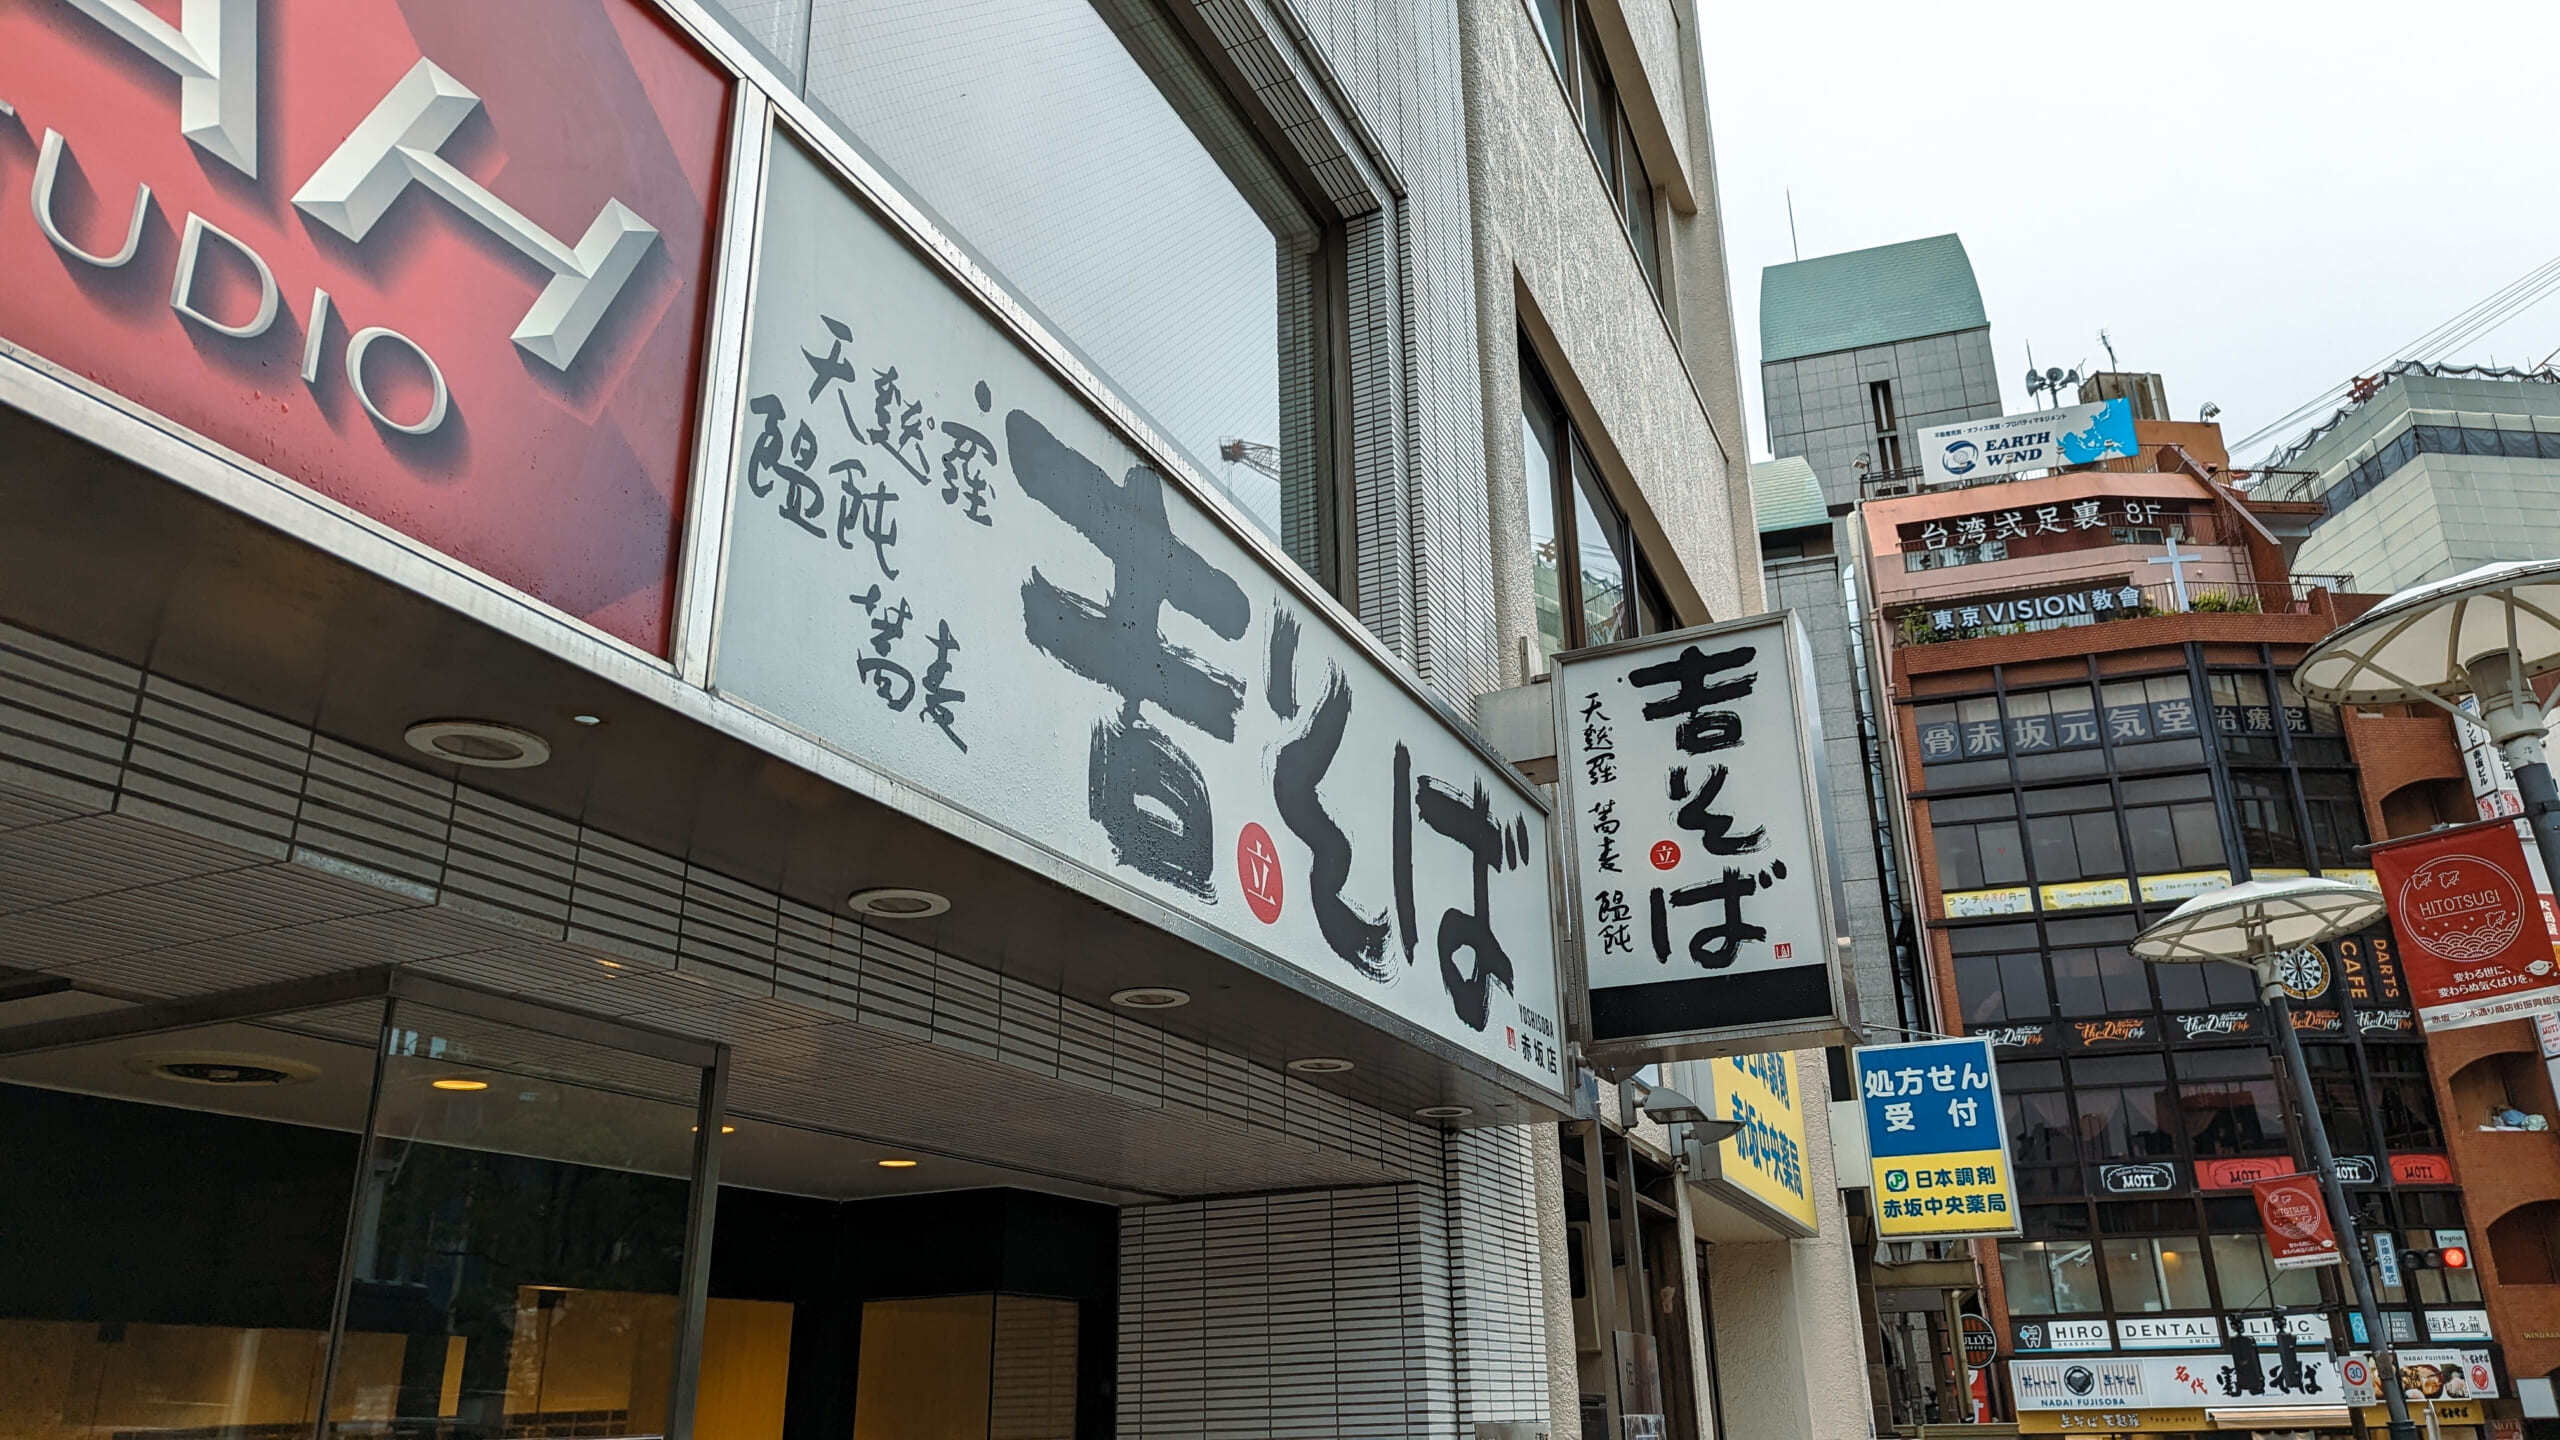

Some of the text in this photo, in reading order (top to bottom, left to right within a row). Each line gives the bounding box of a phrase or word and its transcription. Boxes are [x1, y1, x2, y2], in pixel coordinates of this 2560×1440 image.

[0, 100, 448, 434] UDIO
[1984, 431, 2051, 452] EARTH
[1921, 501, 2107, 551] 台湾式足裏
[1932, 608, 1982, 632] 東京
[1986, 593, 2087, 624] VISION
[1922, 725, 1957, 757] 骨
[1966, 701, 2195, 756] 赤坂元気堂
[1654, 845, 1676, 867] 立
[1245, 838, 1277, 908] 立
[2419, 888, 2501, 918] HITOTSUGI
[2340, 940, 2369, 1000] CAFE
[2373, 938, 2400, 999] DARTS
[2453, 966, 2513, 984] 変わる世に、
[1517, 1003, 1556, 1040] YOSHISOBA
[1519, 1032, 1558, 1075] 赤坂店
[1865, 1063, 1989, 1099] 処方せん
[1731, 1091, 1804, 1200] 赤坂中央薬局
[1915, 1165, 1996, 1190] 日本調剤
[2123, 1174, 2155, 1188] MOTI
[2404, 1164, 2434, 1179] MOTI
[1883, 1193, 2006, 1219] 赤坂中央薬局
[2440, 1235, 2463, 1243] English
[2055, 1325, 2103, 1339] HIRO
[2126, 1322, 2210, 1337] DENTAL
[2349, 1367, 2363, 1379] 30
[2041, 1398, 2125, 1407] NADAI FUJISOBA
